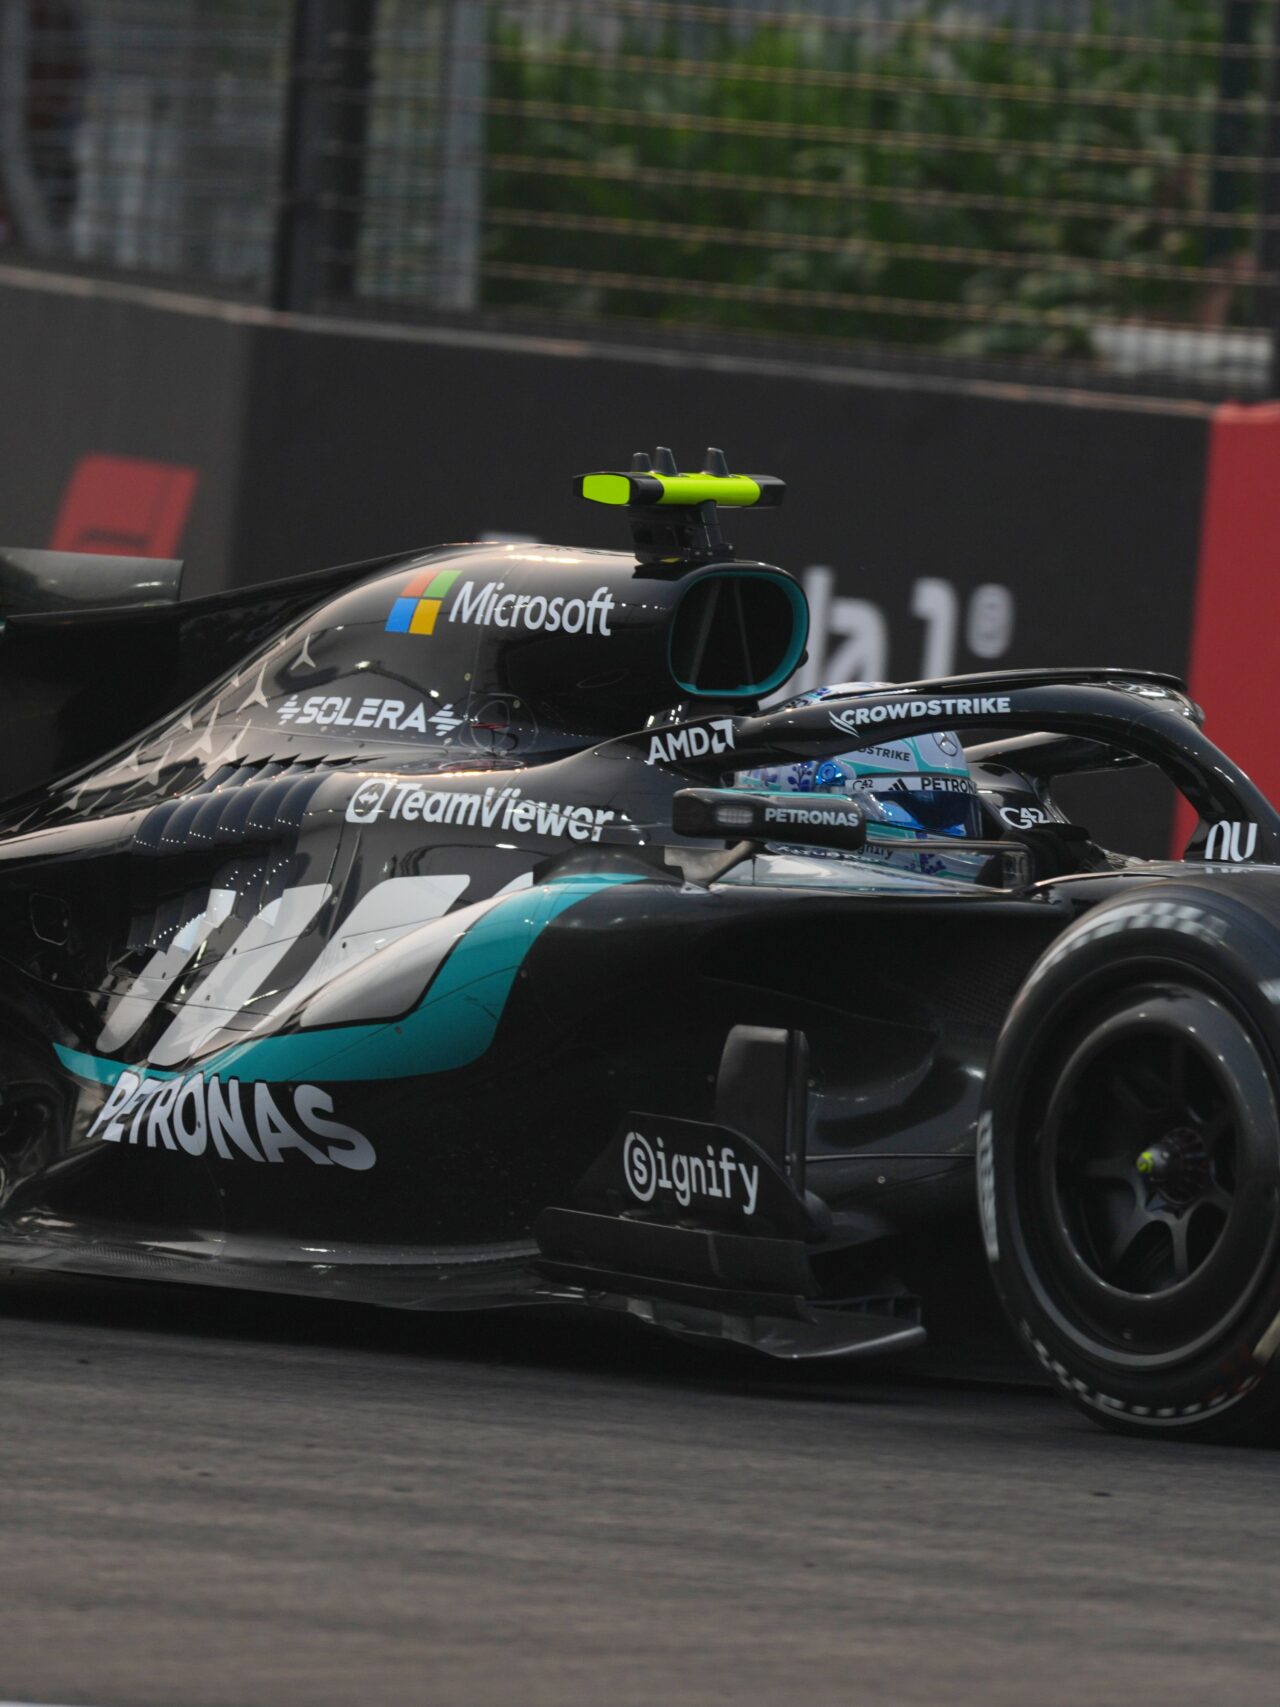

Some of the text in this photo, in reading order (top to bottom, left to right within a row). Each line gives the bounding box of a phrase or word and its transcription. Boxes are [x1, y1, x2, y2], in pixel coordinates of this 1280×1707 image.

[449, 581, 615, 636] Microsoft
[295, 696, 427, 733] SOLERA
[840, 697, 1011, 727] CROWDSTRIKE
[645, 726, 710, 766] AMD
[389, 783, 615, 842] TeamViewer
[764, 807, 860, 828] PETRONAS
[85, 1071, 377, 1171] PETRONAS
